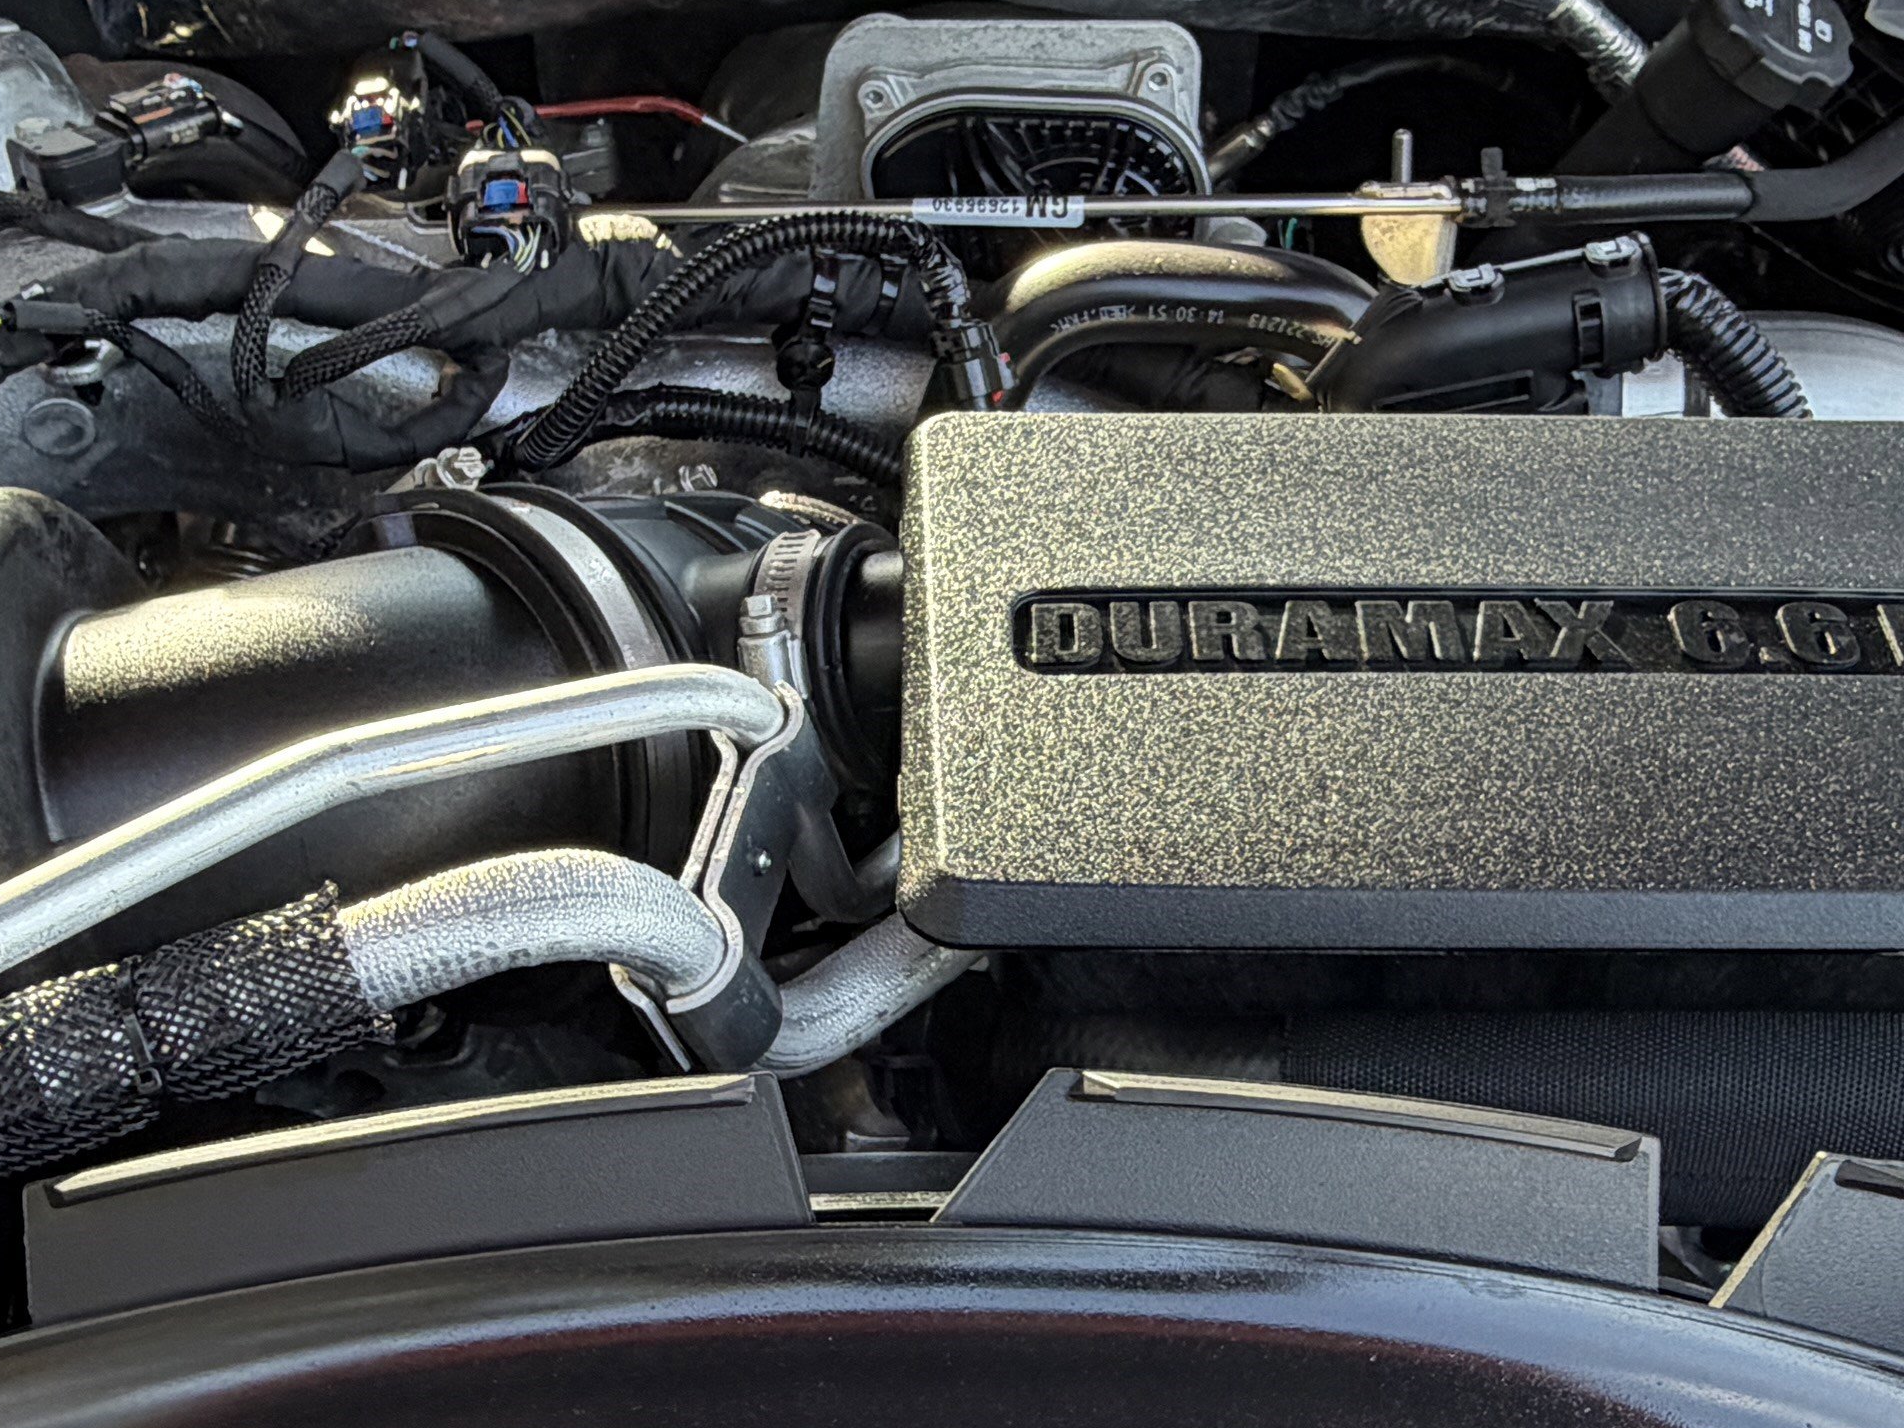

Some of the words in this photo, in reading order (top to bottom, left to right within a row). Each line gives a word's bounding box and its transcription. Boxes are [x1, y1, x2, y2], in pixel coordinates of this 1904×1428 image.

[1025, 194, 1069, 219] GM
[1030, 598, 1627, 668] DURAMAX
[1668, 601, 1859, 670] 6.6
